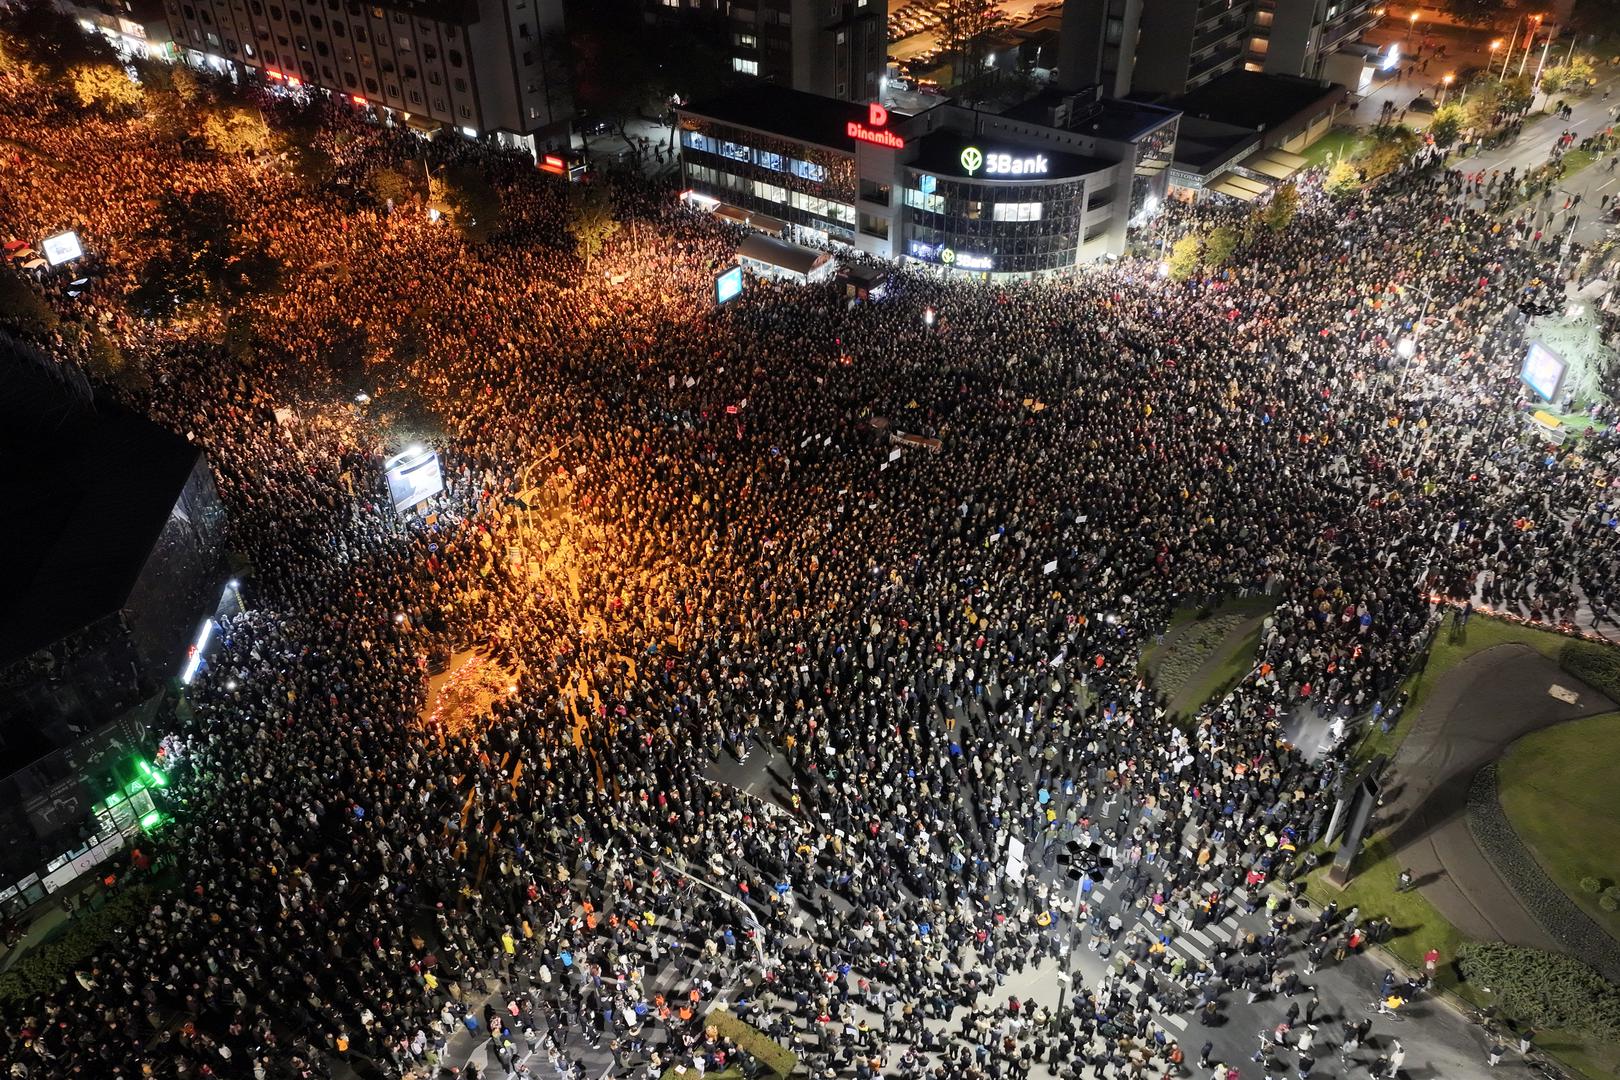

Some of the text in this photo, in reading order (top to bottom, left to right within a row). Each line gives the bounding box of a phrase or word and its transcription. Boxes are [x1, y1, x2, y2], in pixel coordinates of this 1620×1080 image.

[870, 103, 888, 126] D
[847, 122, 904, 149] Dinamika
[986, 153, 1048, 174] 3Bank
